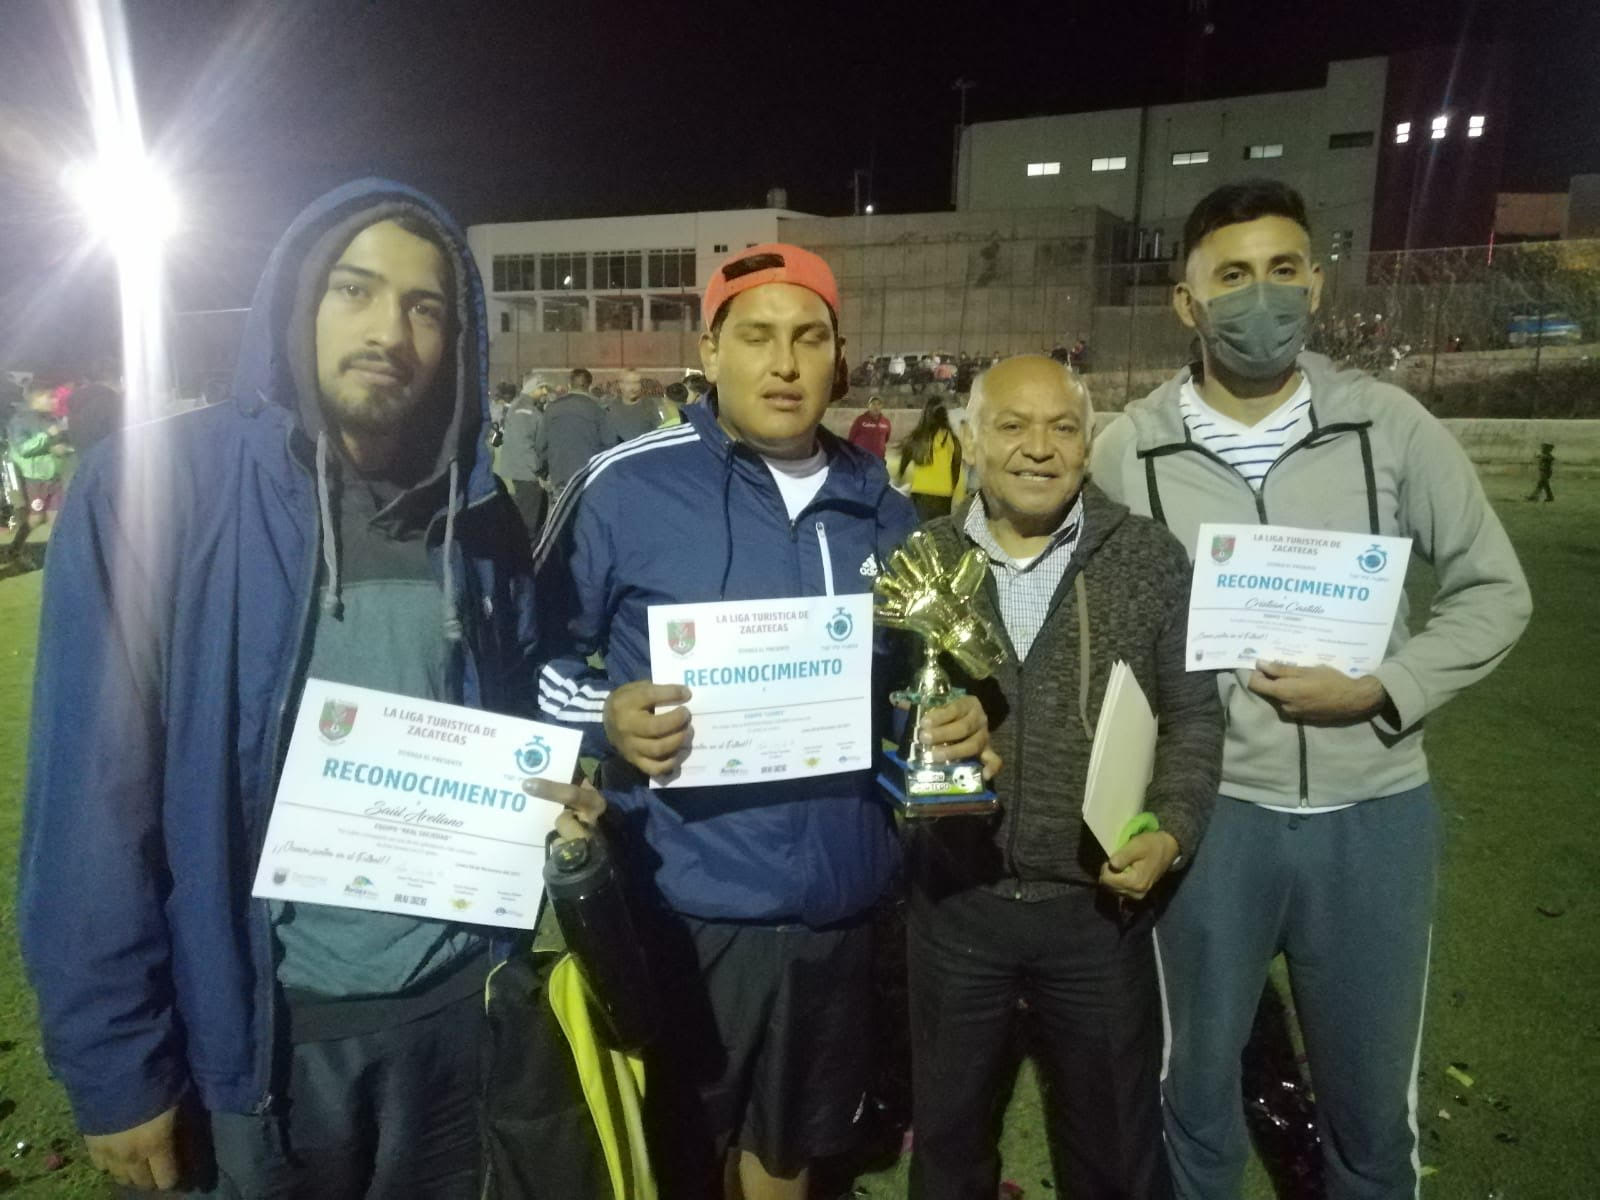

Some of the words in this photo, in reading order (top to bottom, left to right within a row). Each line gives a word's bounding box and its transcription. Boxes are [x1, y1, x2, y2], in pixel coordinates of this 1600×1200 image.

[1253, 533, 1263, 542] LA
[1265, 534, 1284, 543] LIGA
[1286, 535, 1329, 547] TURISTICA
[1330, 540, 1341, 549] DE
[1272, 544, 1318, 556] ZACATECAS
[1216, 574, 1370, 601] RECONOCIMIENTO
[716, 612, 728, 624] LA
[730, 612, 750, 623] LIGA
[752, 610, 798, 622] TURISTICA
[798, 610, 809, 620] DE
[740, 623, 789, 635] ZACATECAS
[684, 658, 843, 687] RECONOCIMIENTO
[383, 706, 397, 718] LA
[399, 709, 424, 724] LIGA
[427, 714, 482, 735] TURISTICA
[482, 726, 497, 738] DE
[407, 725, 467, 745] ZACATECAS
[322, 757, 527, 814] RECONOCIMIENTO
[403, 808, 464, 828] Arellano
